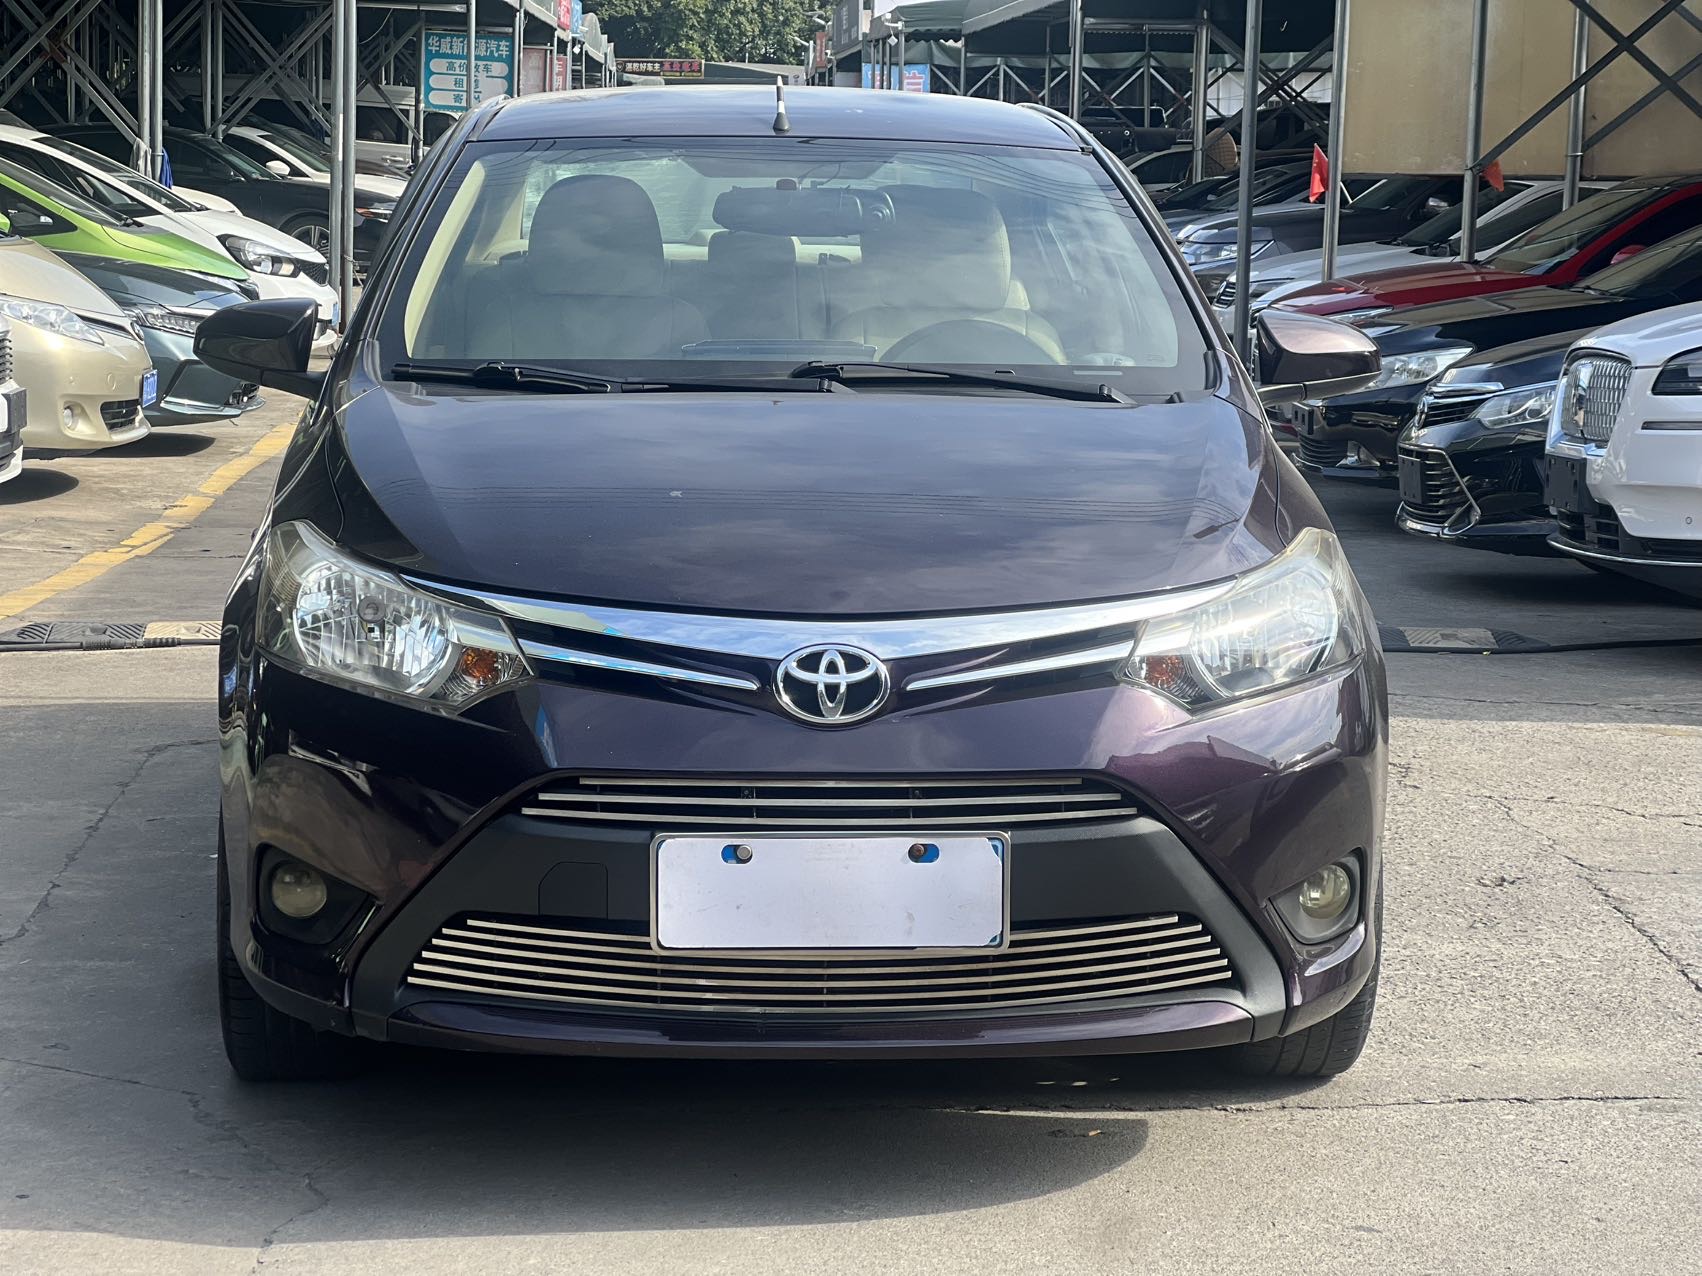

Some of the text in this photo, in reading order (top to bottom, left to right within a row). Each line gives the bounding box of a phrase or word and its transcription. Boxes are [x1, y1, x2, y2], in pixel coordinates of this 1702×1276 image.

[428, 35, 510, 58] 华威新源汽车
